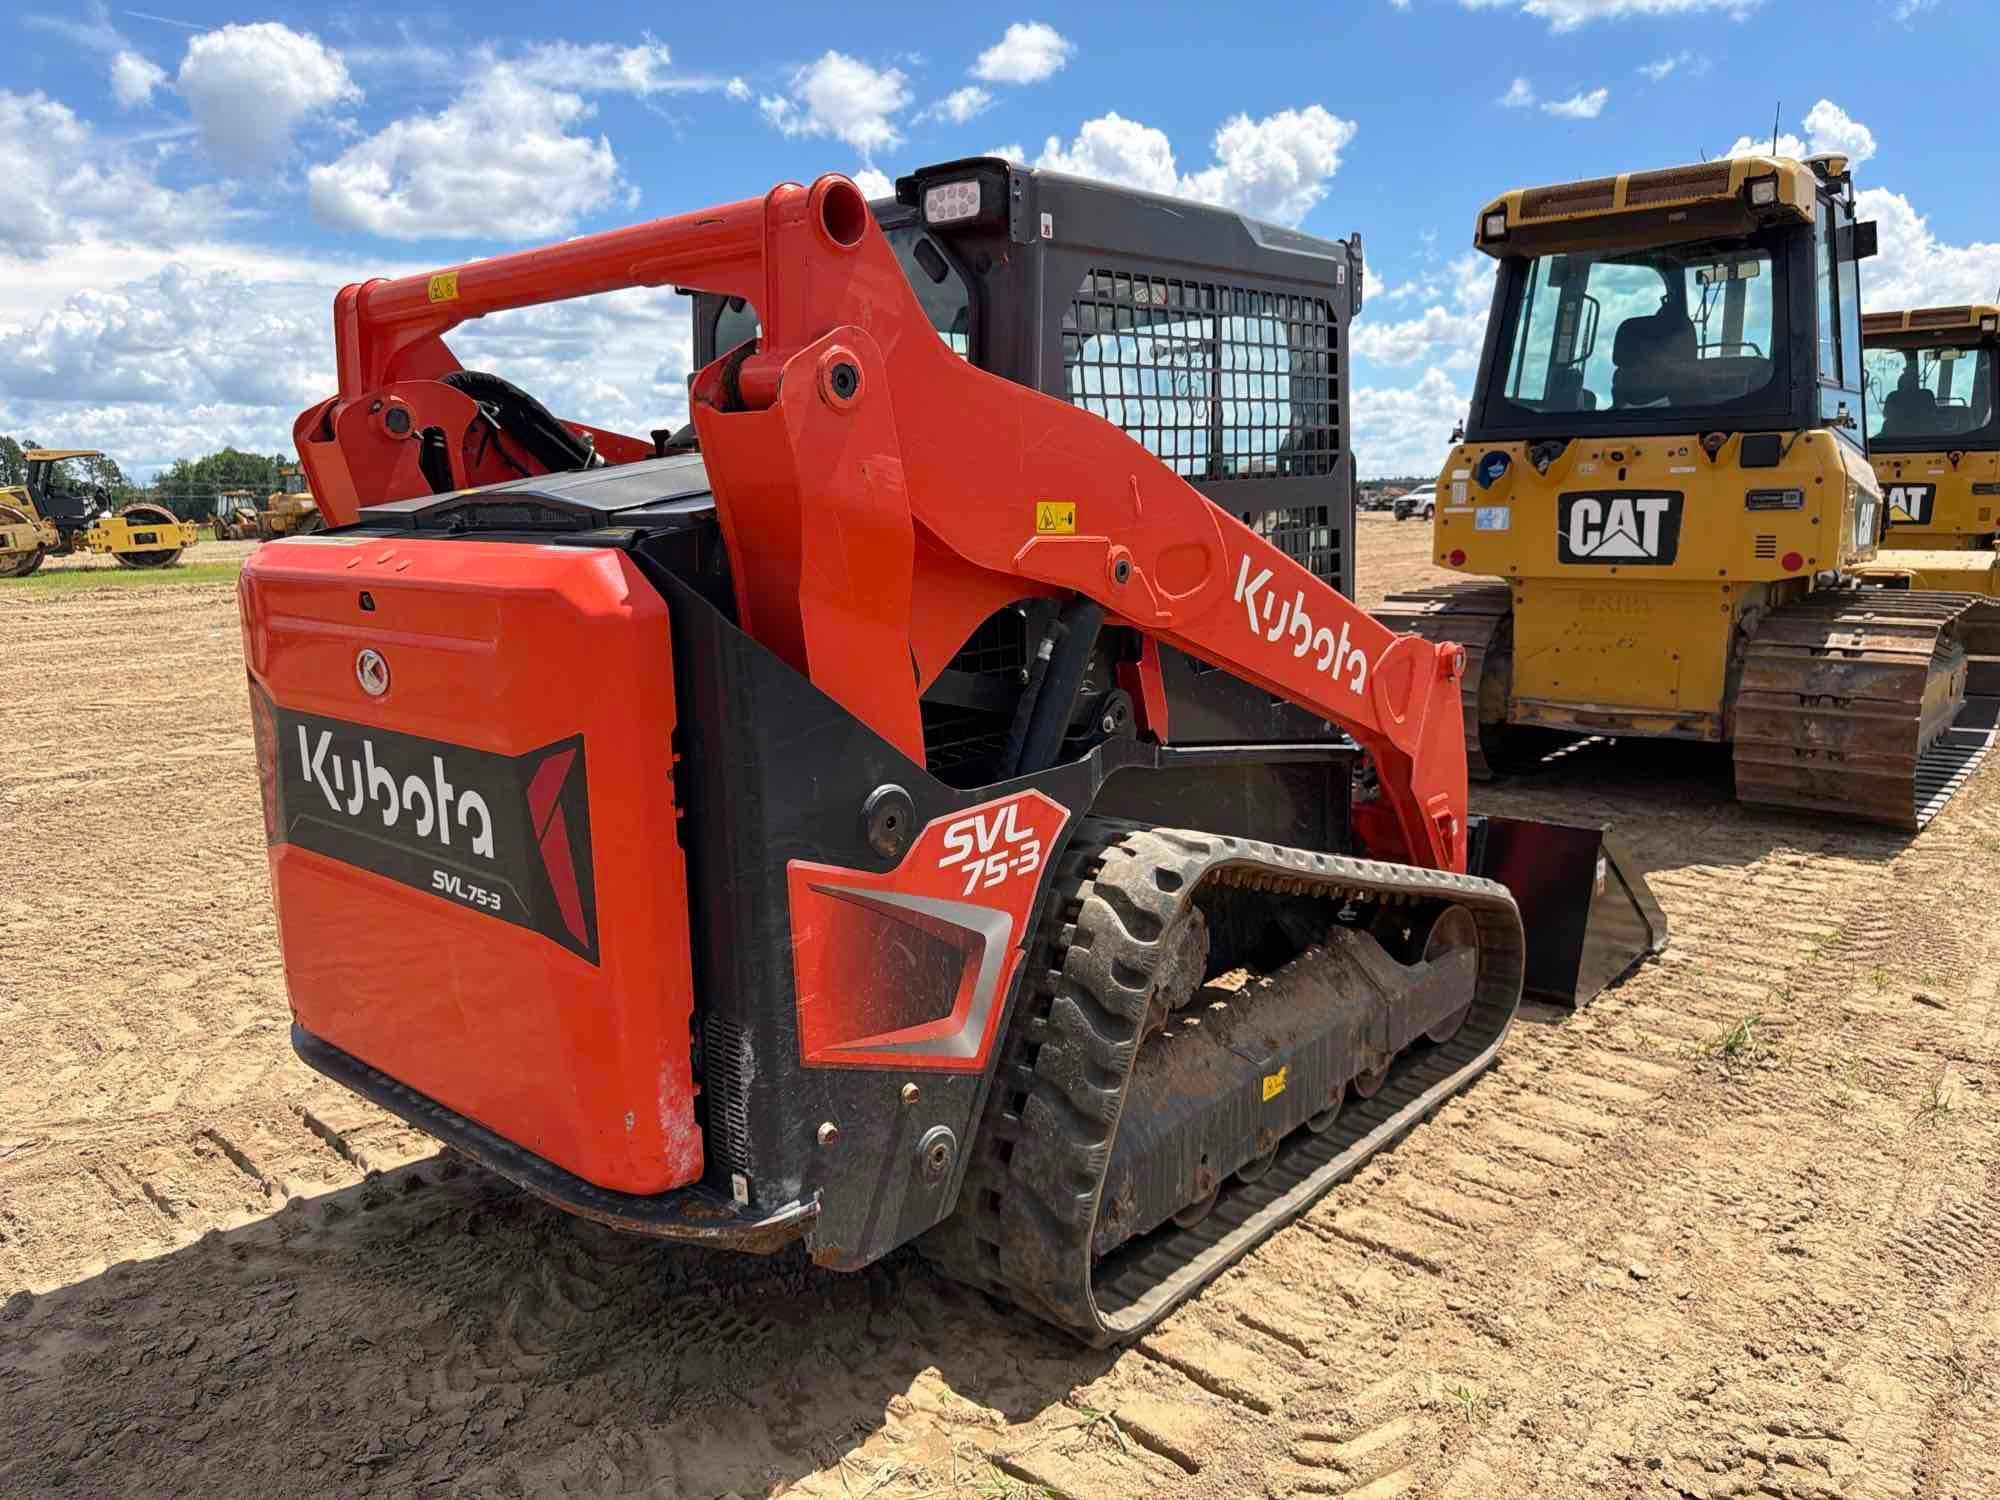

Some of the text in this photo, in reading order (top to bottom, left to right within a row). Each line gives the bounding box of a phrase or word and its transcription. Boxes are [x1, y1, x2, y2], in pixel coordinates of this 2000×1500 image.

[1568, 498, 1669, 557] CAT
[1889, 487, 1928, 521] AT
[1234, 554, 1367, 695] Kubota
[297, 725, 495, 859] Kubota
[939, 804, 1034, 868] SVL
[961, 840, 1040, 897] 75-3
